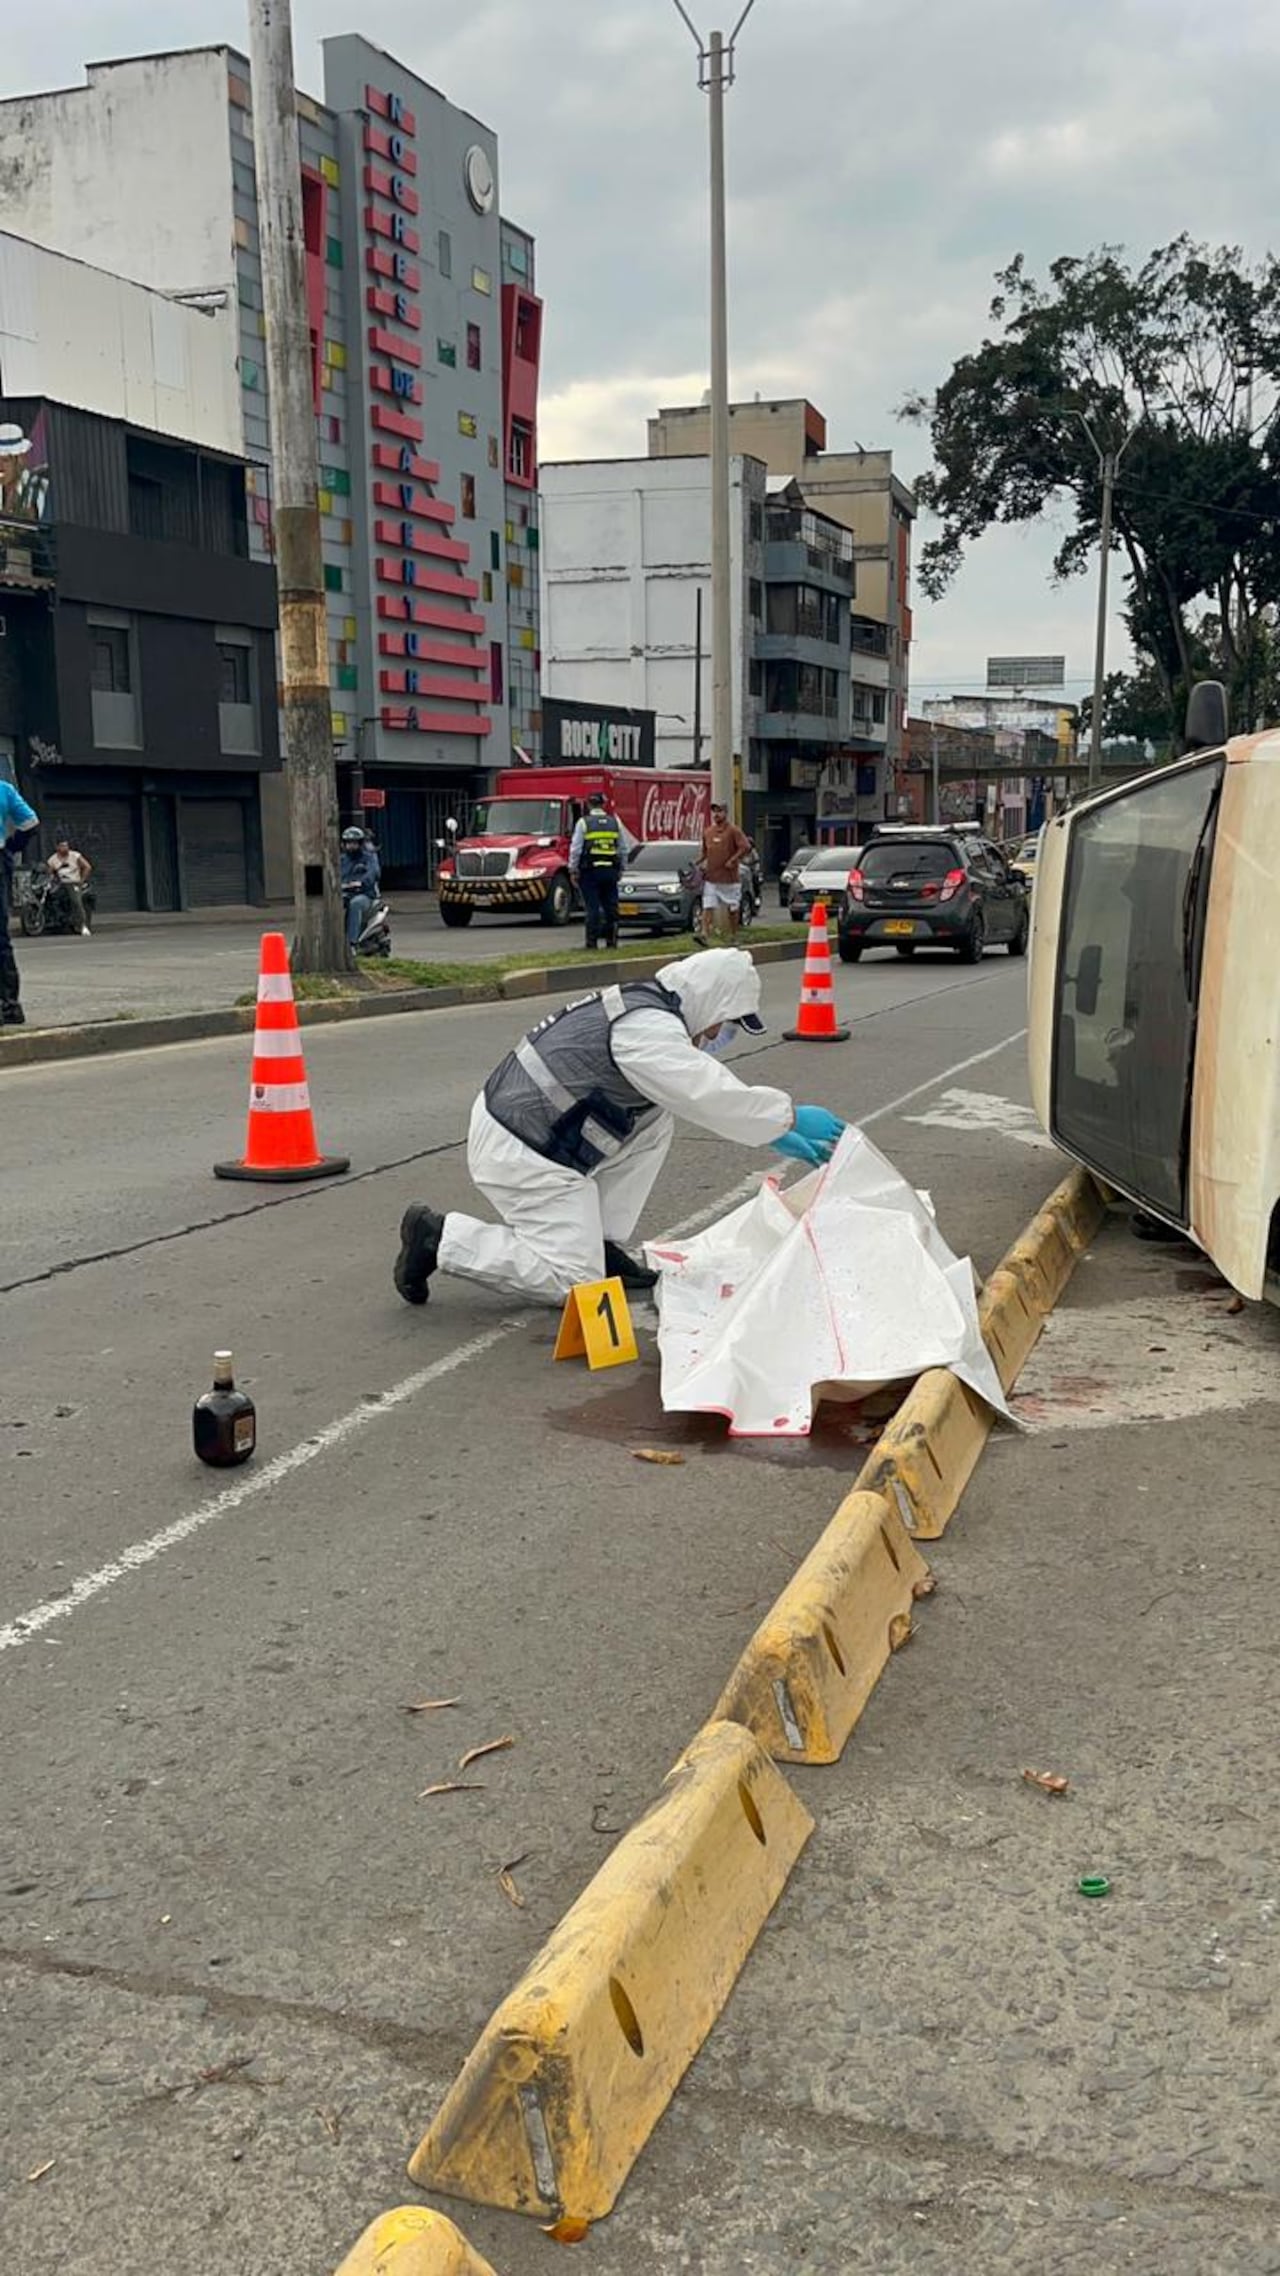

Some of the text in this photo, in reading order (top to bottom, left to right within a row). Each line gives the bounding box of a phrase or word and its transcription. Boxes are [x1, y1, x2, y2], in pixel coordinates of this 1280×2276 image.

[391, 366, 415, 400] DE
[399, 442, 420, 732] AVENTURA
[561, 719, 641, 760] ROCK CITY
[597, 1291, 620, 1347] 1
